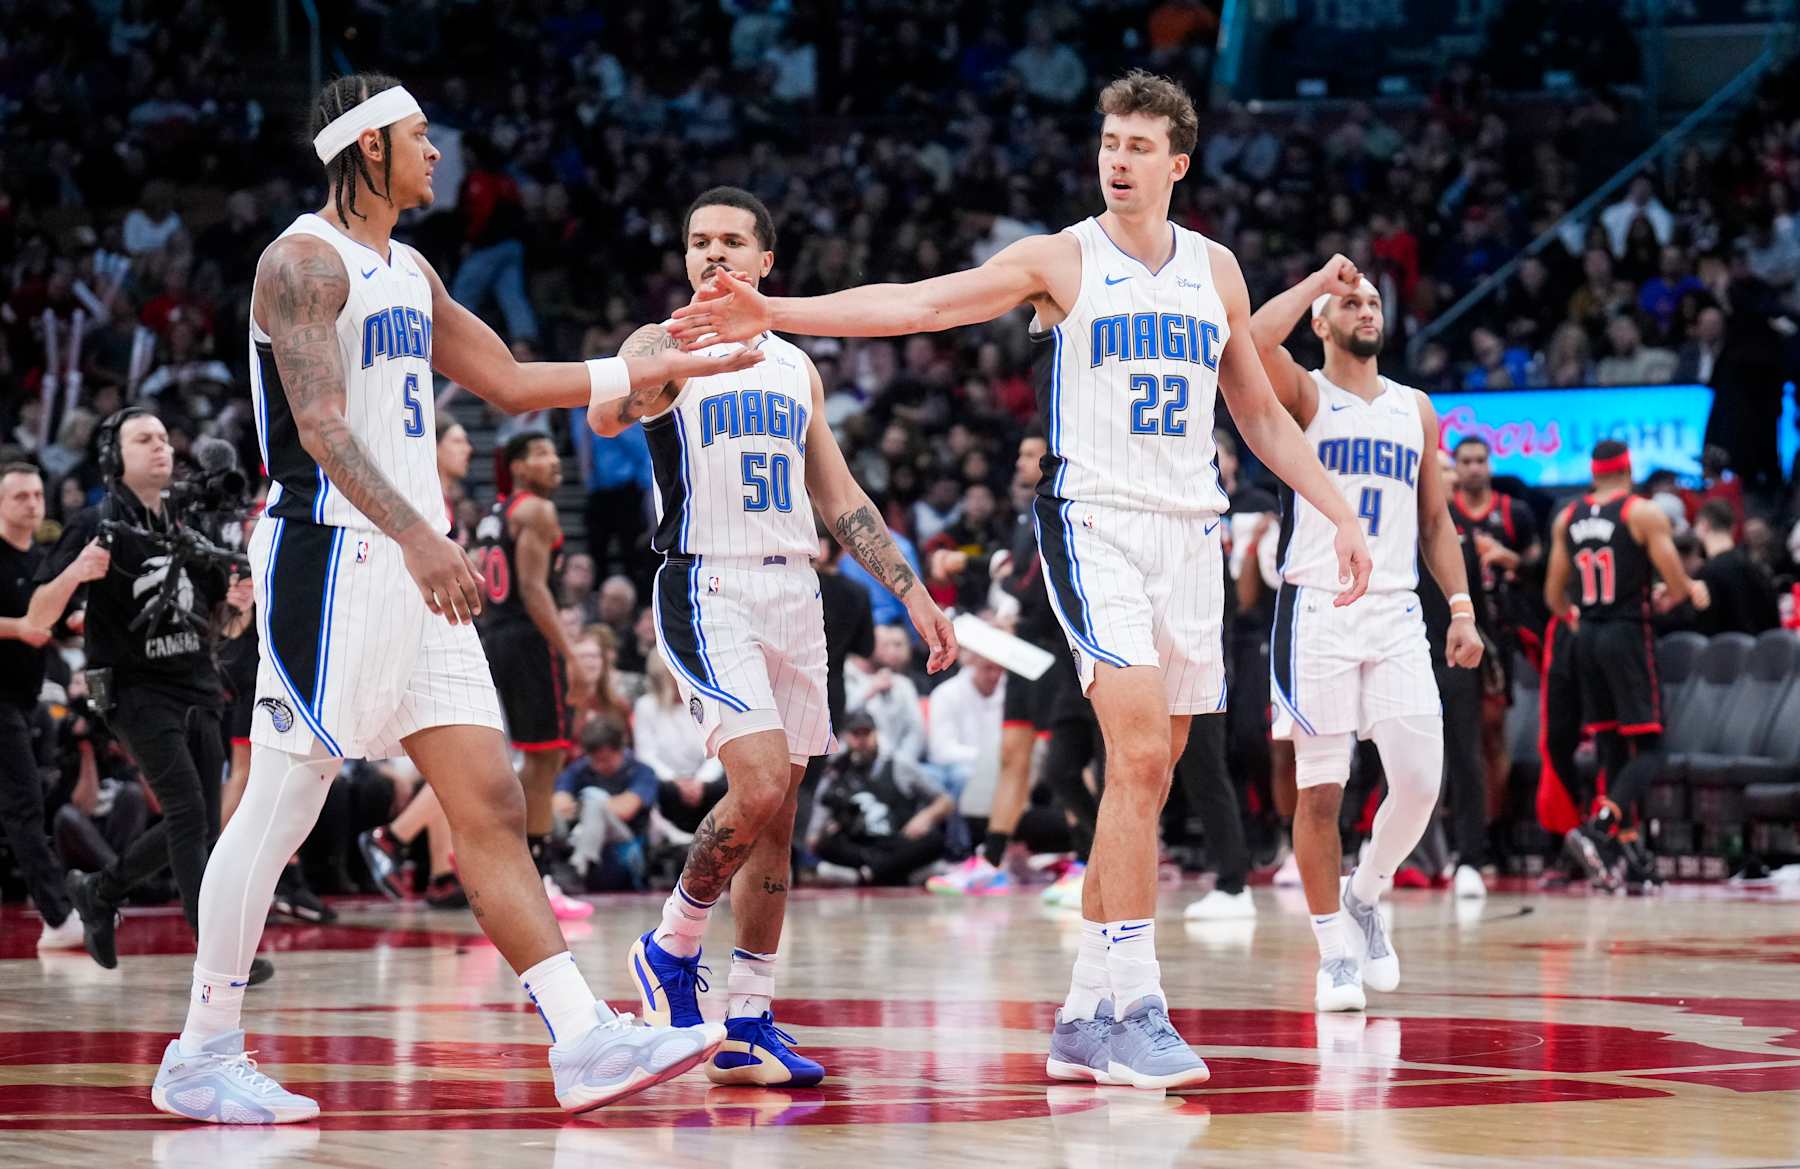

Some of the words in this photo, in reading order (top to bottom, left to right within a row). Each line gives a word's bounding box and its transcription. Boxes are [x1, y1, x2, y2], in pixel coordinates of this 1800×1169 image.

[1090, 311, 1220, 373] MAGIC
[403, 372, 426, 438] 5
[700, 389, 808, 458] MAGIC
[1129, 373, 1190, 437] 22
[740, 451, 793, 514] 50
[1318, 436, 1419, 491] MAGIC
[1358, 486, 1383, 537] 4
[1575, 546, 1616, 606] 11
